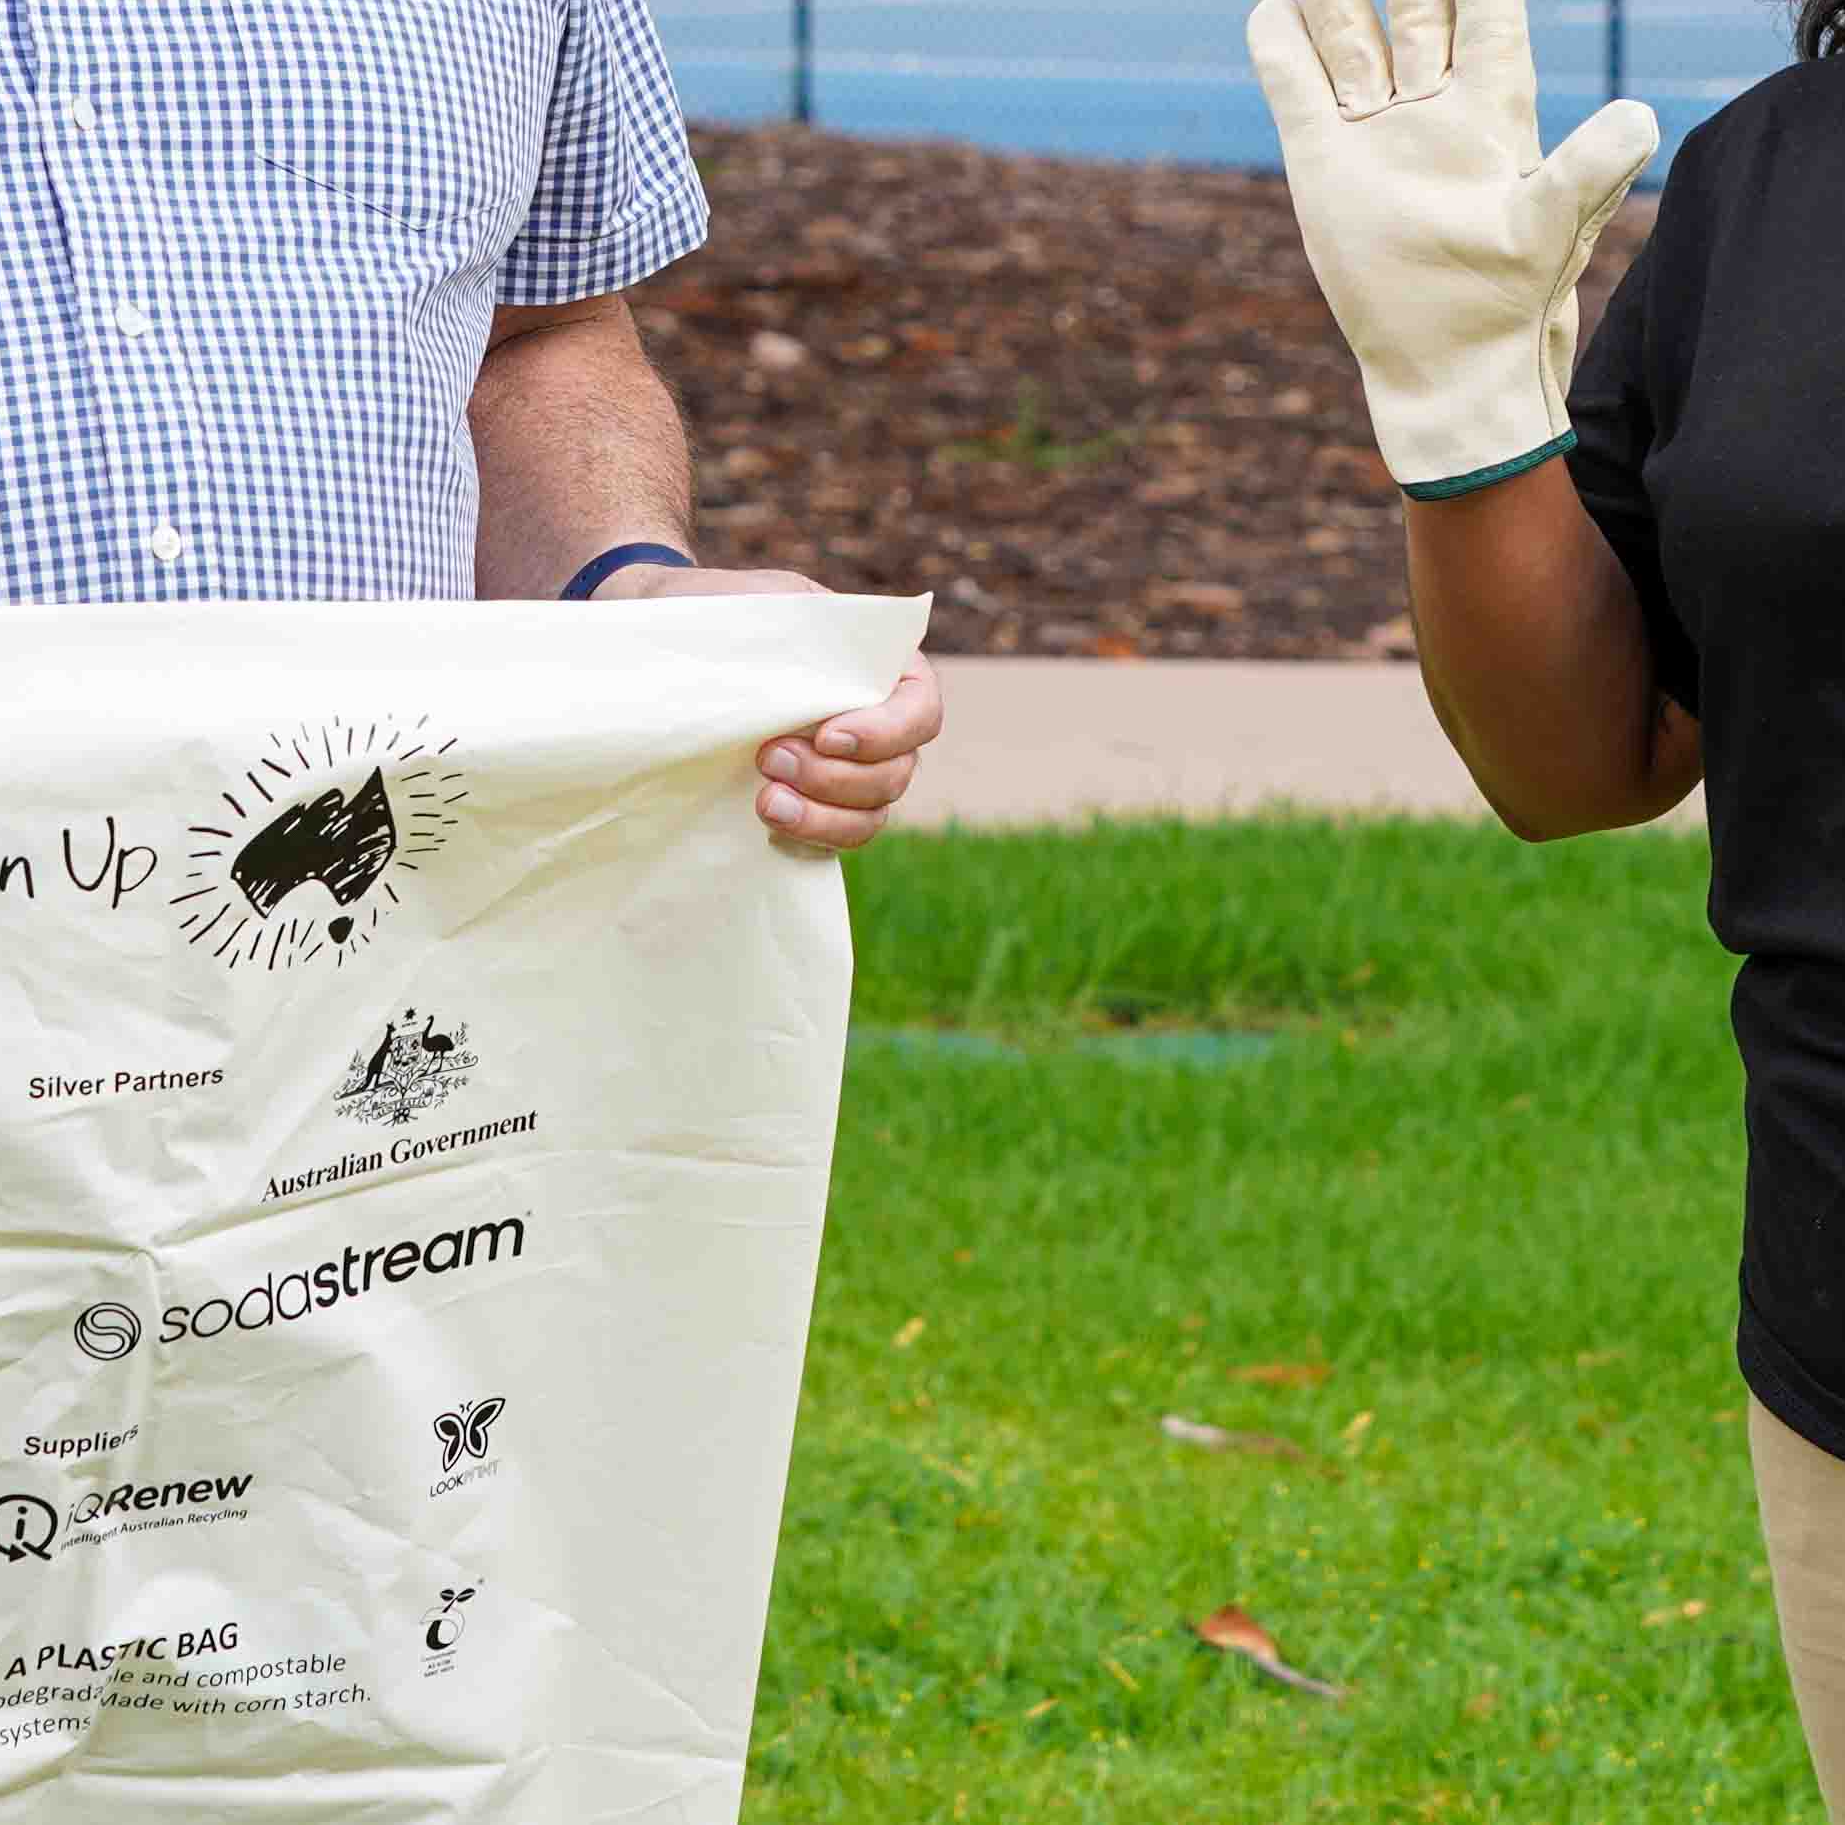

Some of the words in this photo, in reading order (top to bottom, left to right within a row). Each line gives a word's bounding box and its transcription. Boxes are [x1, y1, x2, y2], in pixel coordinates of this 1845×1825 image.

[63, 816, 157, 909] Up
[28, 1074, 105, 1099] Silver
[114, 1067, 225, 1093] Partners
[261, 1150, 383, 1203] Australian
[390, 1110, 538, 1164] Government
[159, 1215, 525, 1344] sodastream
[23, 1425, 139, 1458] Suppliers
[65, 1473, 254, 1531] iQRenew
[119, 1515, 184, 1533] Australian
[187, 1508, 249, 1525] Recycling
[4, 1657, 27, 1681] A
[37, 1637, 167, 1672] PLASTIC
[176, 1623, 239, 1659] BAG
[142, 1668, 188, 1688] and
[196, 1654, 347, 1688] compostable
[173, 1694, 226, 1715] with
[233, 1697, 287, 1715] corn
[294, 1684, 372, 1711] starch.
